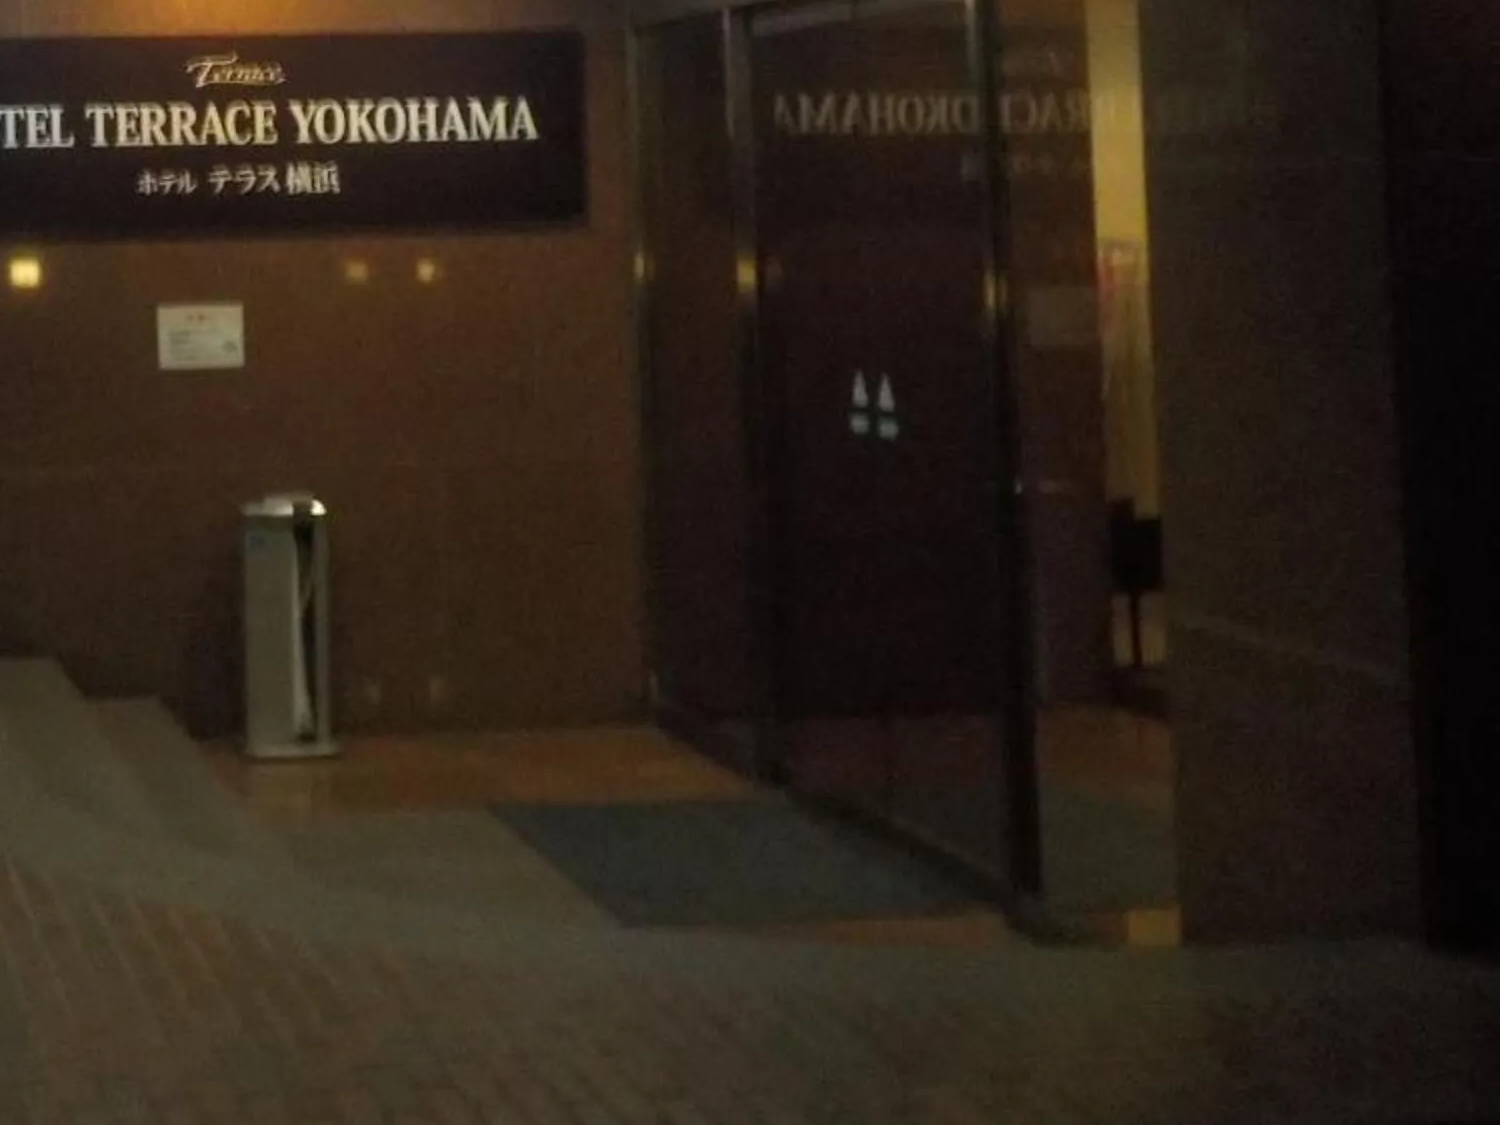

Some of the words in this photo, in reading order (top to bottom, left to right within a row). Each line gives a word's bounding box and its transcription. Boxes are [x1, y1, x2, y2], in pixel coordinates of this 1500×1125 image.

[84, 101, 278, 147] TERRACE
[287, 96, 539, 144] YOKOHAMA
[136, 169, 198, 195] ホテル
